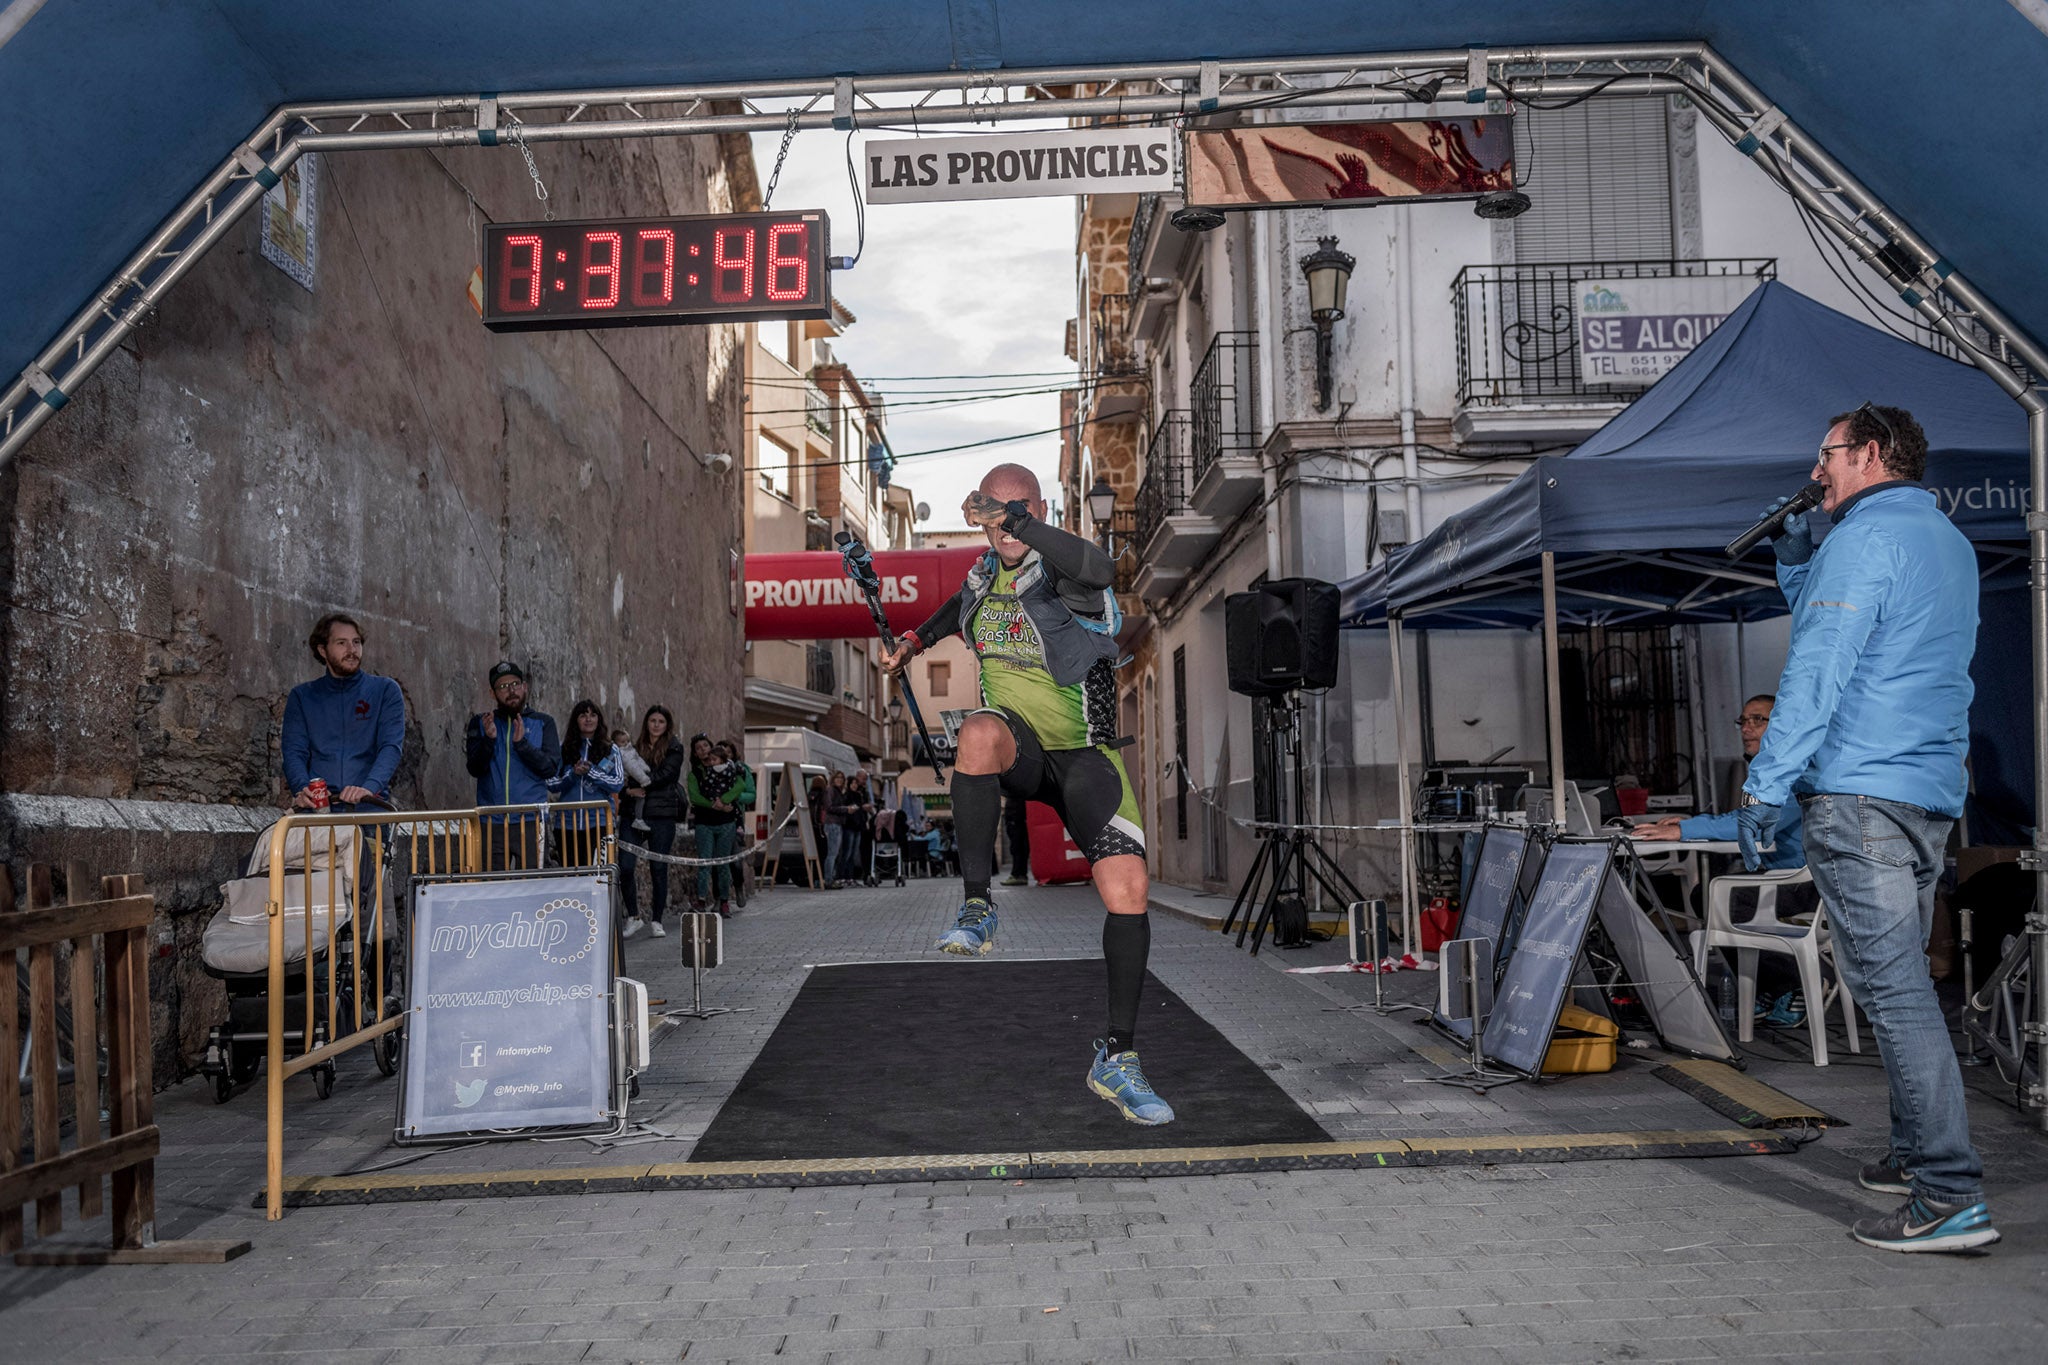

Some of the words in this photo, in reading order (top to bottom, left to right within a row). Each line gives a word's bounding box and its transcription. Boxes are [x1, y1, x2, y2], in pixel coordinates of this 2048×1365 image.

[870, 154, 938, 188] LAS
[947, 143, 1168, 185] PROVINCIAS
[505, 223, 807, 309] 7:37:46
[1587, 319, 1623, 350] SE
[1636, 317, 1725, 350] ALQU
[1631, 356, 1657, 366] 651
[1632, 367, 1658, 376] 964
[745, 575, 919, 609] PROVINCAS
[980, 605, 1027, 624] Runnin
[431, 911, 568, 959] mychip
[427, 982, 593, 1009] www.mychip.es
[495, 1044, 552, 1057] /infomychip
[494, 1082, 563, 1097] @Mychip_Info
